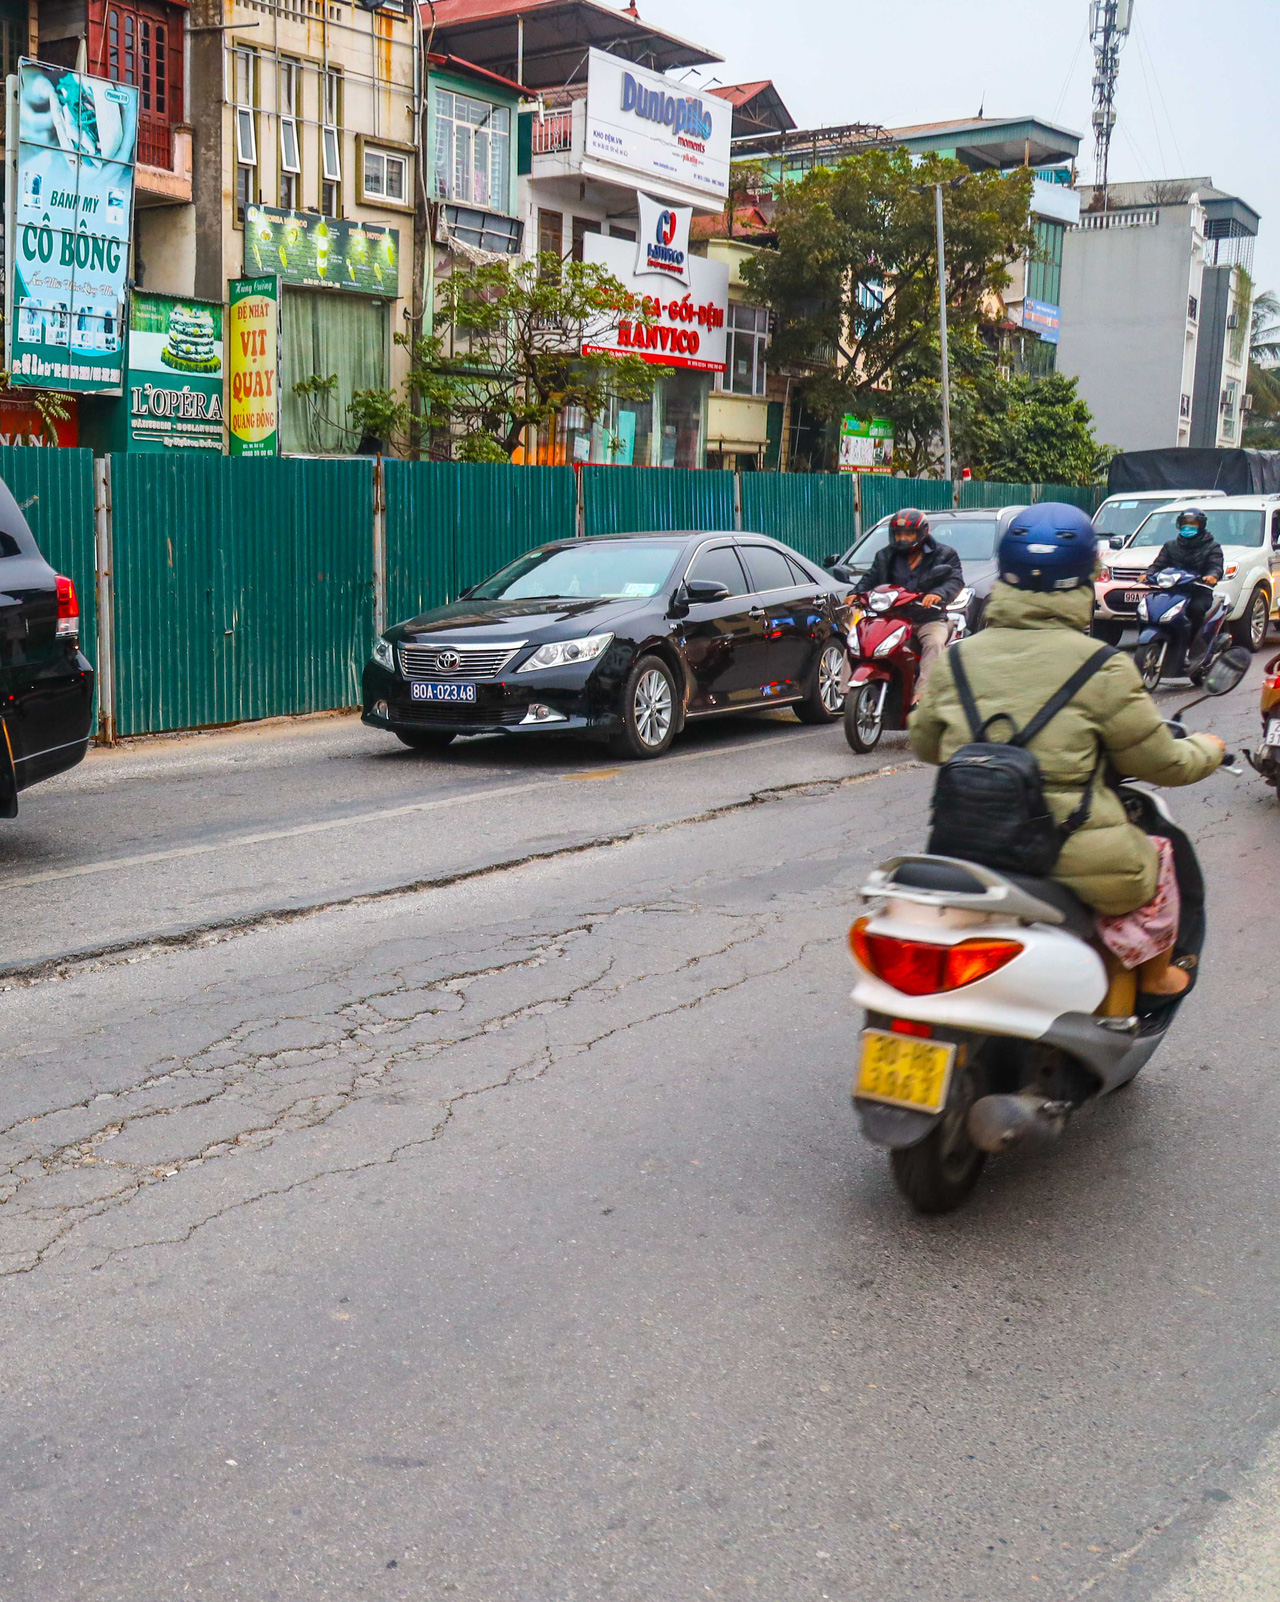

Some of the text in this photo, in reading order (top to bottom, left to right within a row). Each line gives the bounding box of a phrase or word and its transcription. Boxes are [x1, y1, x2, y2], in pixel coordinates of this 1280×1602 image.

[677, 135, 706, 154] moments
[22, 212, 121, 274] CÔ BÔNG
[237, 297, 270, 323] ĐỆ NHẤT
[240, 329, 267, 364] VỊT
[617, 320, 700, 355] HANVICO
[233, 370, 274, 403] QUAY
[232, 407, 255, 433] QUẢNG
[412, 683, 474, 700] 80A-023.48
